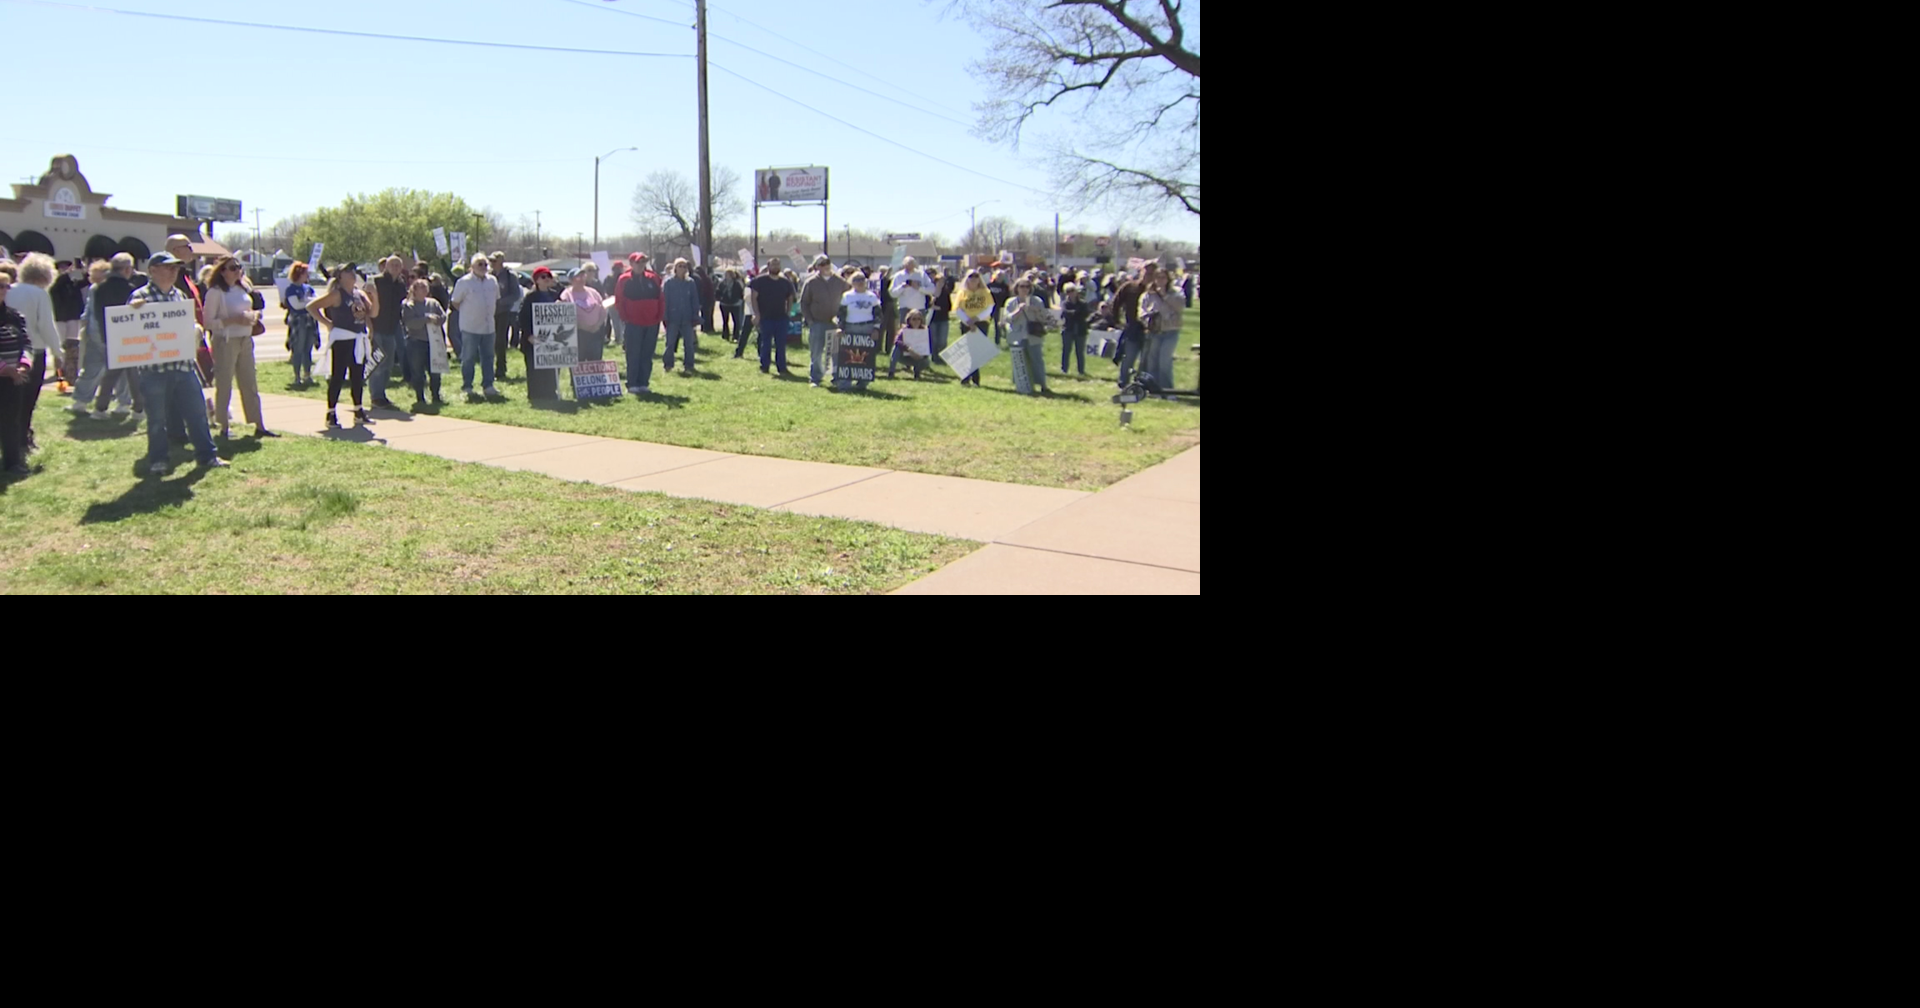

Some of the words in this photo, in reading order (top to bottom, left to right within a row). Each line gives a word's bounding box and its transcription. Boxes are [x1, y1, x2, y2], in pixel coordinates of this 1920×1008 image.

[535, 304, 567, 316] BLESSED
[111, 314, 134, 323] WEST
[163, 310, 186, 318] KINGS
[841, 335, 851, 344] NO
[853, 335, 875, 347] KINGS
[537, 355, 577, 366] KINGMAKERS
[575, 362, 616, 373] ELECTIONS
[839, 367, 849, 378] NO
[852, 368, 873, 379] WARS
[576, 375, 607, 385] BELONG
[609, 374, 618, 382] TO
[592, 385, 620, 396] PEOPLE
